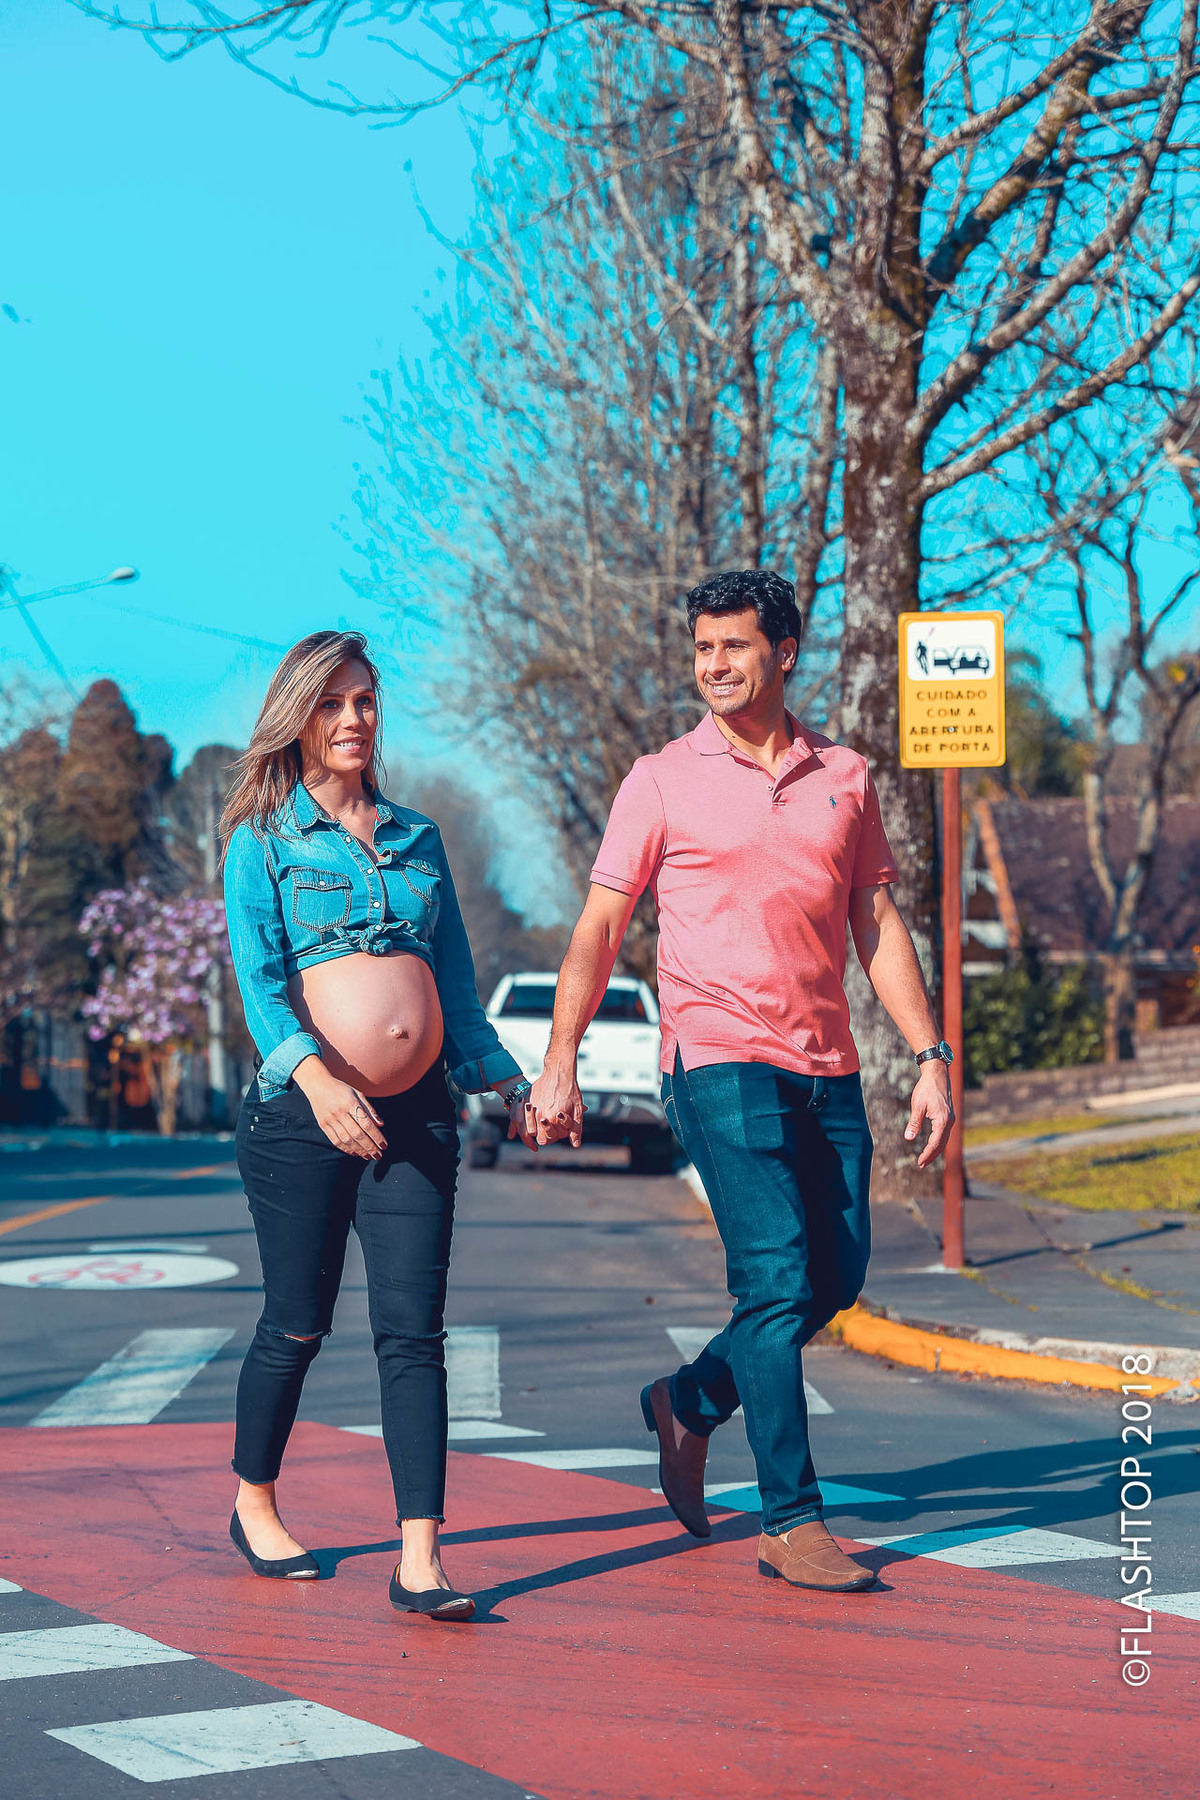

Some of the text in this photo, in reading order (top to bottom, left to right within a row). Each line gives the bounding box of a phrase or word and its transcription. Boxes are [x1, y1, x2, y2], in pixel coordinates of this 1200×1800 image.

[916, 690, 988, 701] CUIDADO
[926, 708, 977, 718] COM A
[909, 725, 994, 736] ABERTURA
[913, 742, 990, 753] DE PORTA
